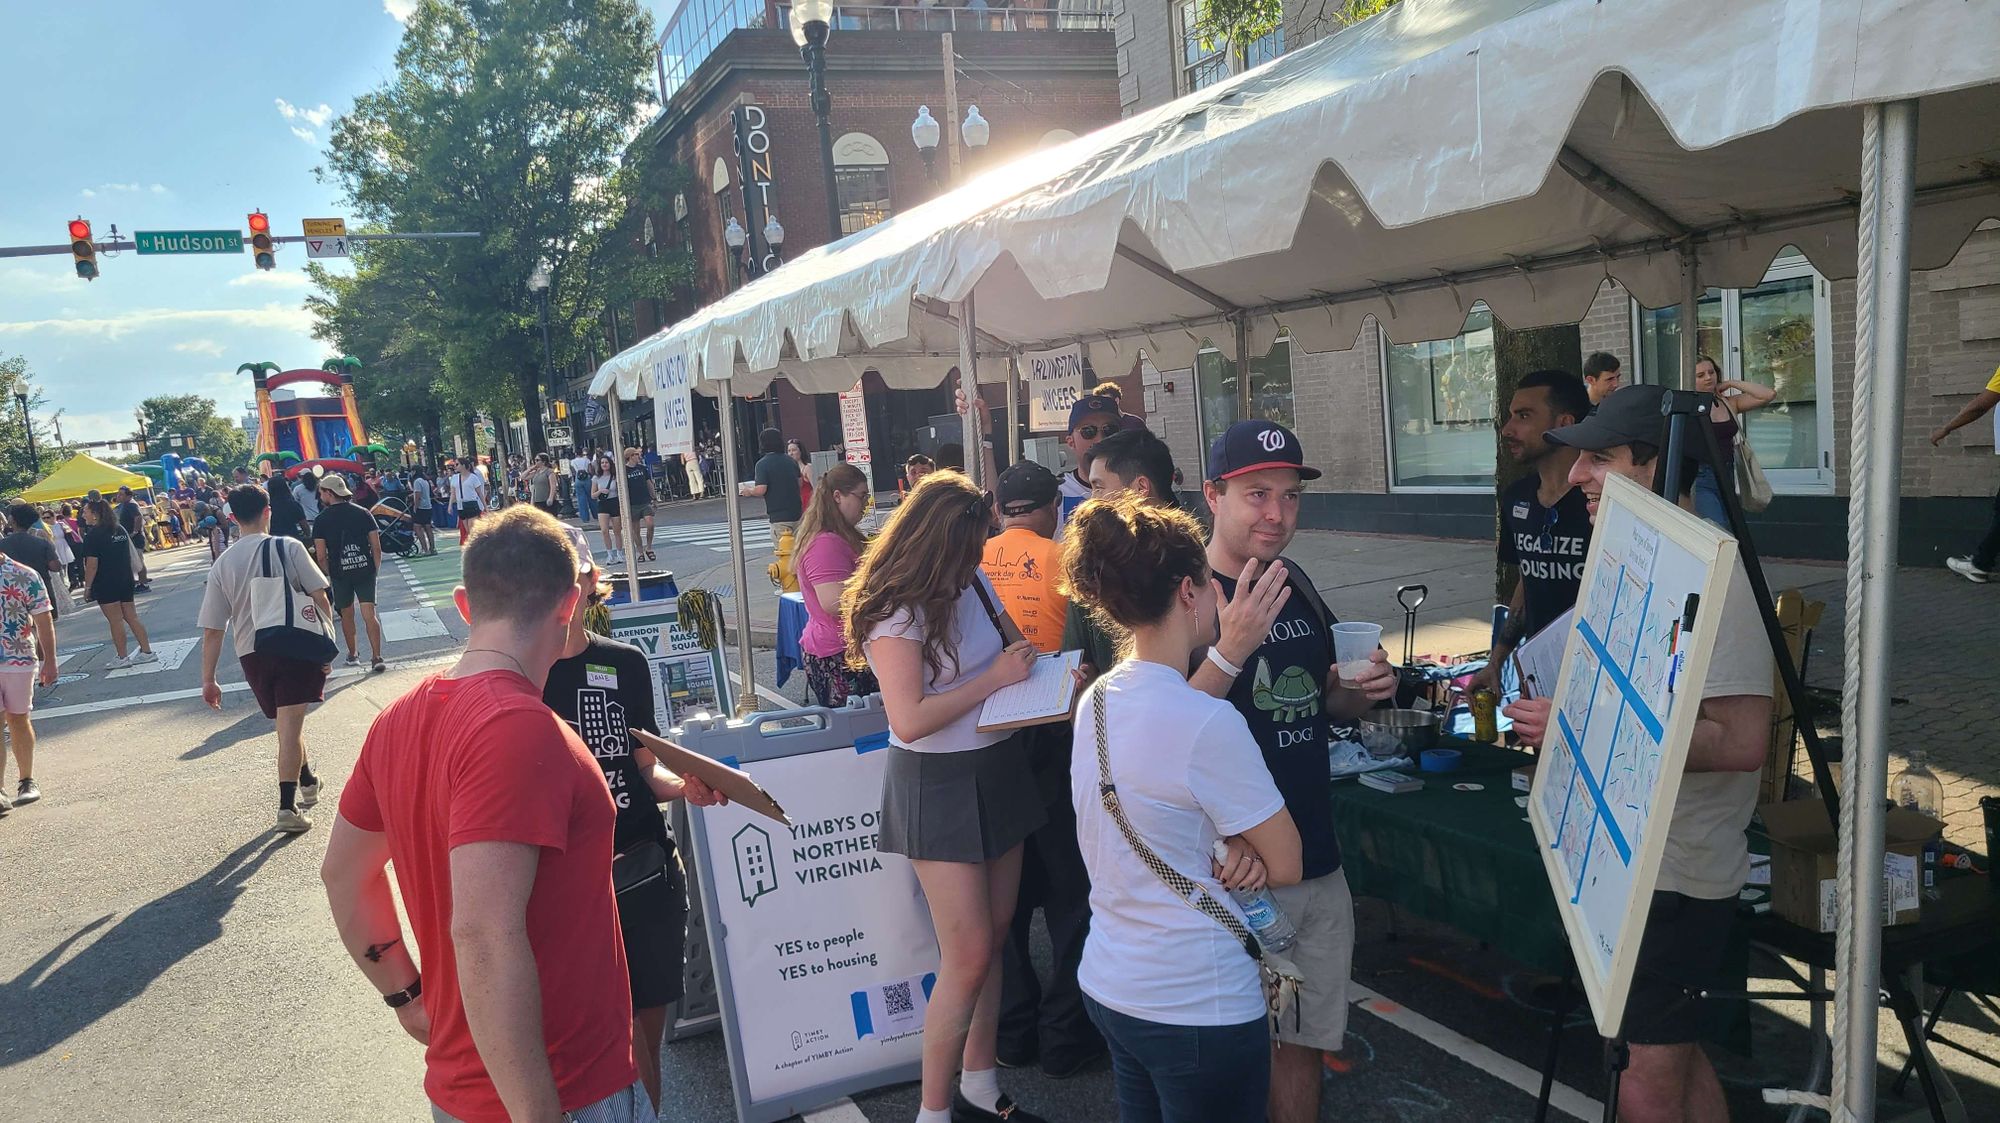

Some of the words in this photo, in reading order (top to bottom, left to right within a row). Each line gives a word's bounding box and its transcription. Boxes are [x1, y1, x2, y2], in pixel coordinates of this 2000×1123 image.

[142, 239, 149, 248] N
[153, 235, 226, 252] Hudson
[229, 238, 238, 247] St
[1257, 429, 1285, 452] W
[1514, 533, 1584, 556] LEGAIZE
[1003, 570, 1015, 578] day
[1520, 559, 1585, 580] OUSING
[670, 632, 699, 643] MASO
[687, 679, 713, 688] SQUARE
[788, 815, 856, 841] YIMBYS
[795, 856, 883, 885] VIRGINIA
[774, 940, 803, 957] YES
[806, 939, 820, 951] to
[823, 928, 865, 952] people
[778, 964, 808, 981] YES
[811, 963, 824, 975] to
[827, 952, 879, 972] housing
[805, 1034, 829, 1044] ACTION
[781, 1059, 804, 1069] chapter
[804, 1056, 811, 1064] of
[811, 1050, 833, 1062] YIMBY
[834, 1046, 854, 1056] Action
